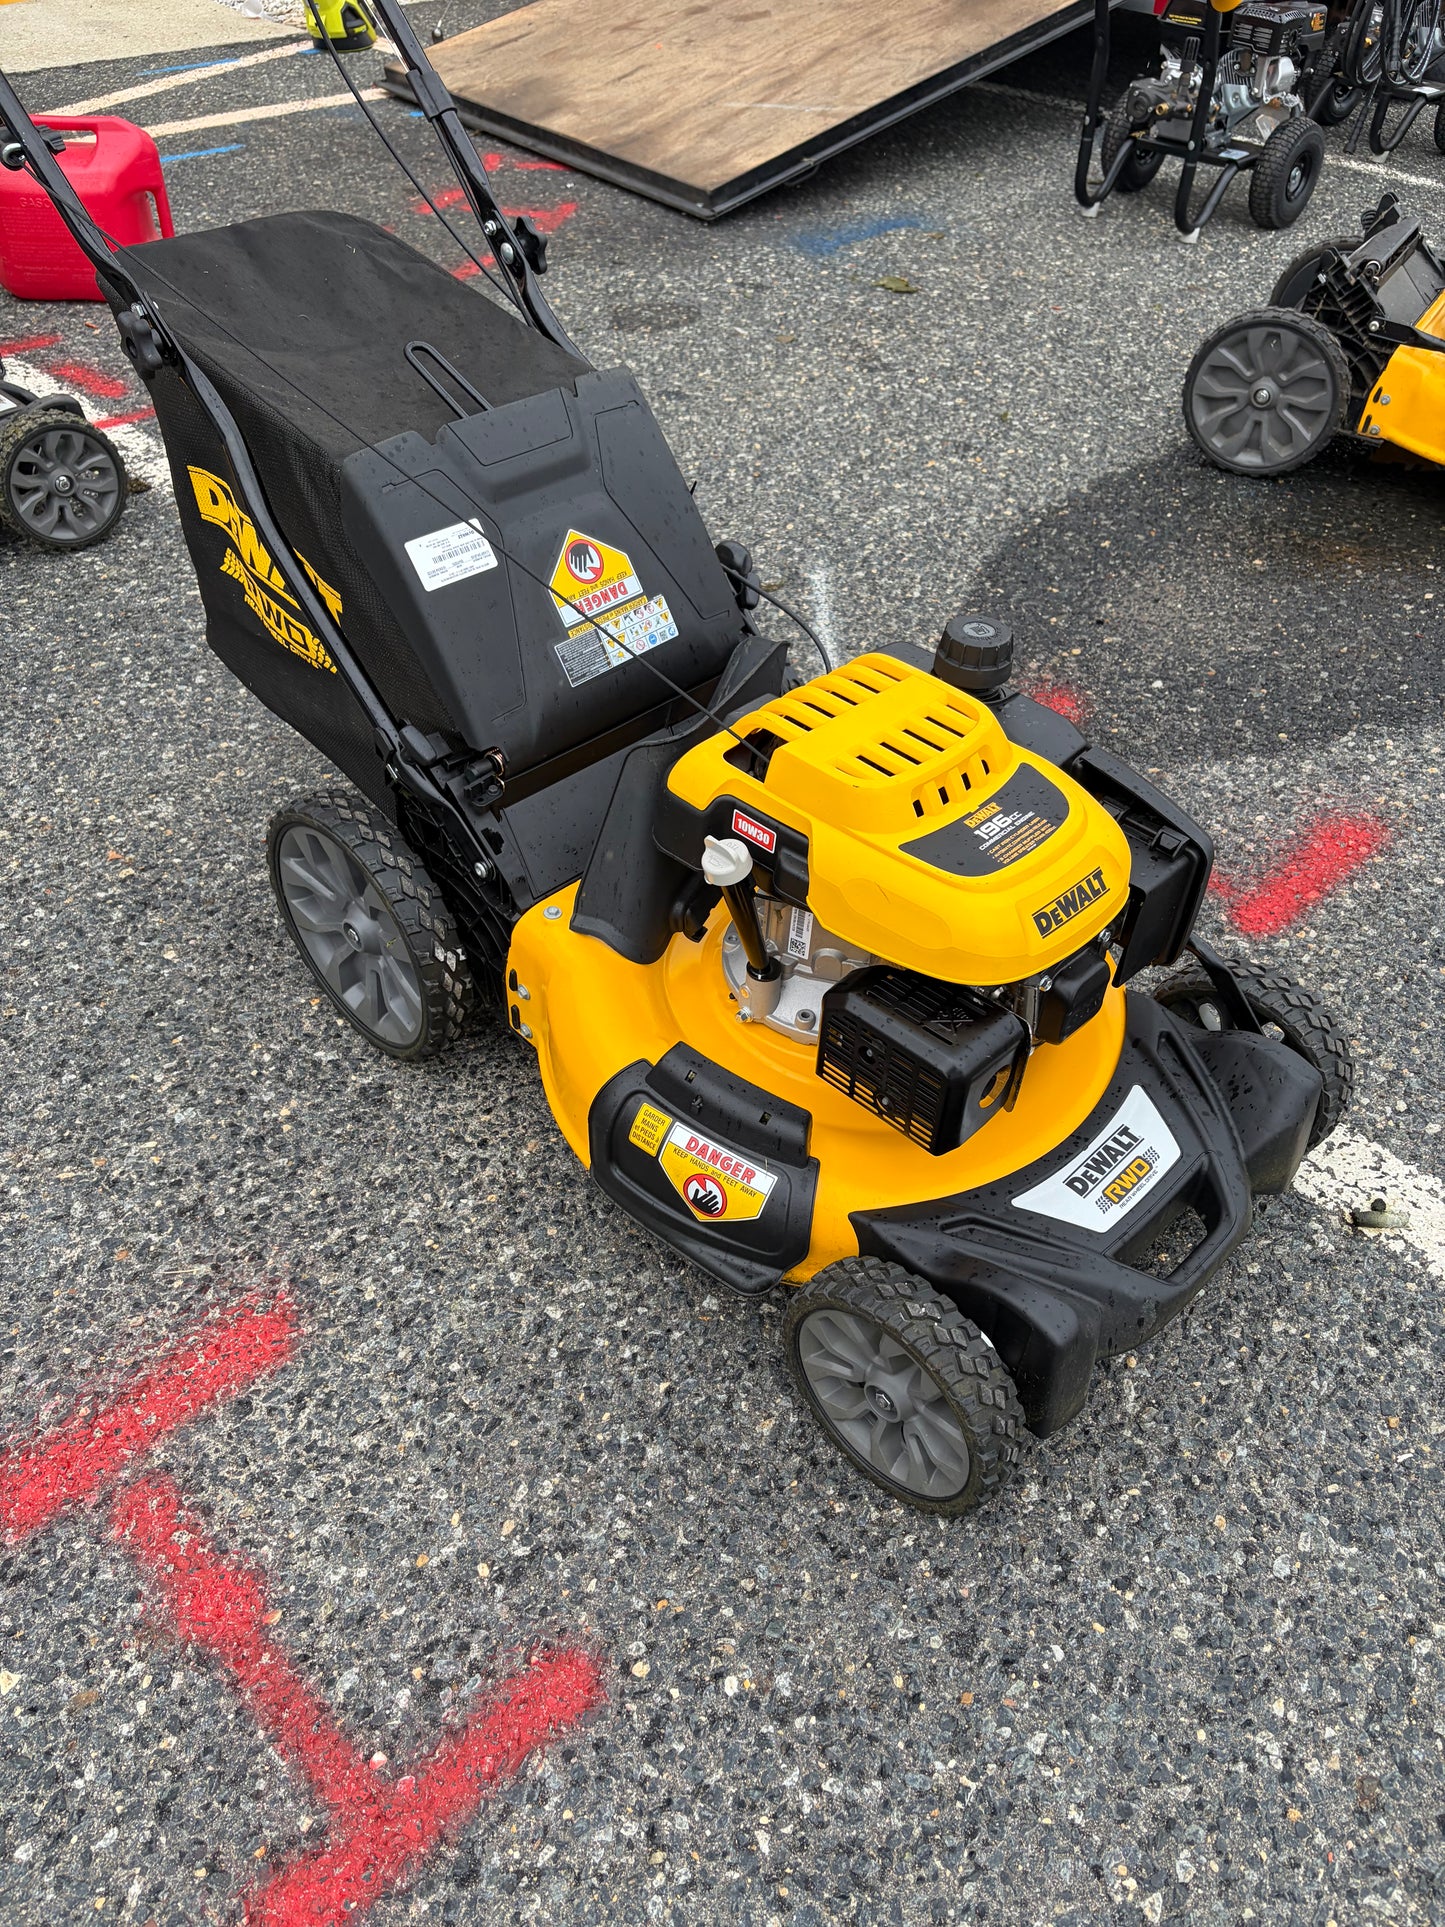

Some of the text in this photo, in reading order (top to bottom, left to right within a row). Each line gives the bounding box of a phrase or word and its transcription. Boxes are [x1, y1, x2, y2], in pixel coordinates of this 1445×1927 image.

[573, 581, 629, 614] DANGER
[737, 818, 770, 845] 10W30
[979, 825, 1017, 851] COMMERCIAL
[641, 1117, 659, 1133] MAINS
[643, 1109, 666, 1126] GARDER
[632, 1131, 656, 1151] DISTANCE
[640, 1126, 656, 1140] PIEDS
[673, 1147, 757, 1198] KEEP HANDS and FEET AWAY
[685, 1136, 756, 1184] DANGER
[1104, 1158, 1151, 1203] RWD
